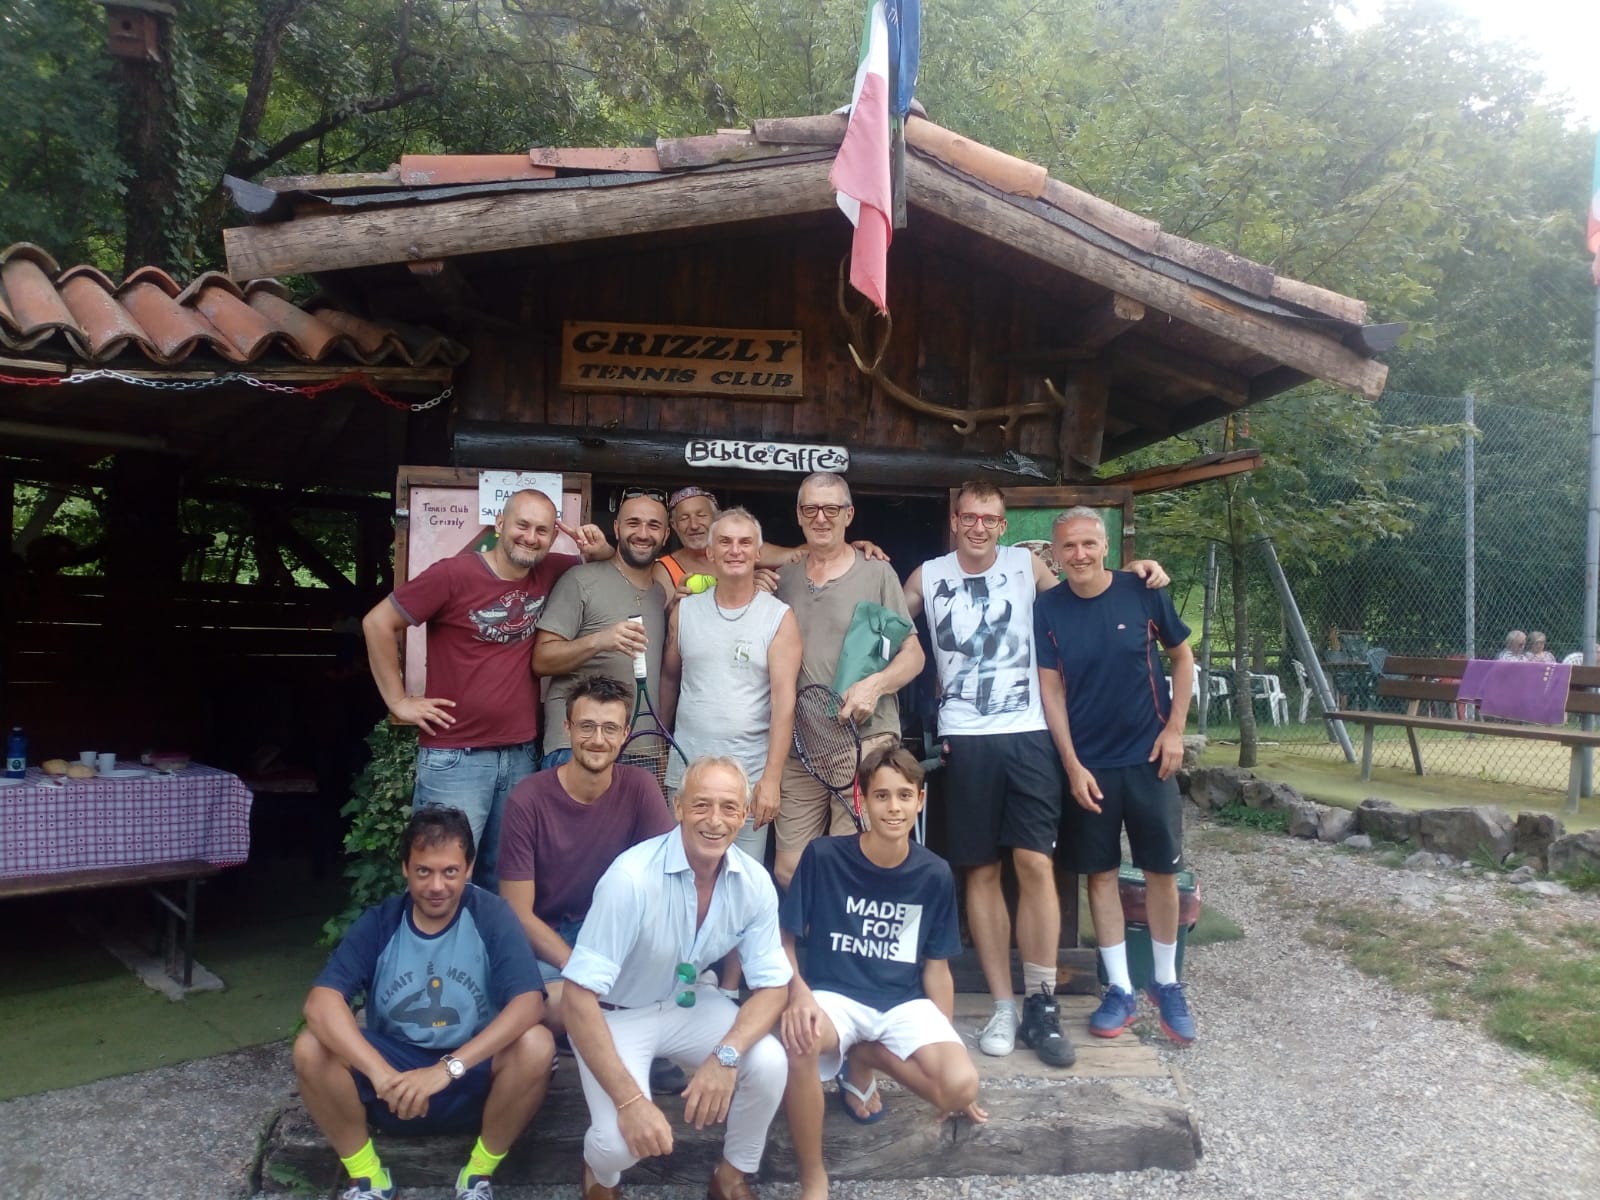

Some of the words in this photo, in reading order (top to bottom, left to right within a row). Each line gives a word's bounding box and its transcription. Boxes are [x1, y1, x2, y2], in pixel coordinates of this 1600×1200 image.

[572, 329, 798, 363] GRIZZLY
[577, 363, 697, 383] TENNIS
[710, 371, 793, 388] CLUB
[495, 489, 515, 502] PA
[422, 502, 446, 513] Tennis
[449, 504, 469, 513] Club
[429, 514, 465, 530] Grizzly
[846, 895, 906, 921] MADE
[862, 918, 904, 940] FOR
[830, 932, 901, 960] TENNIS
